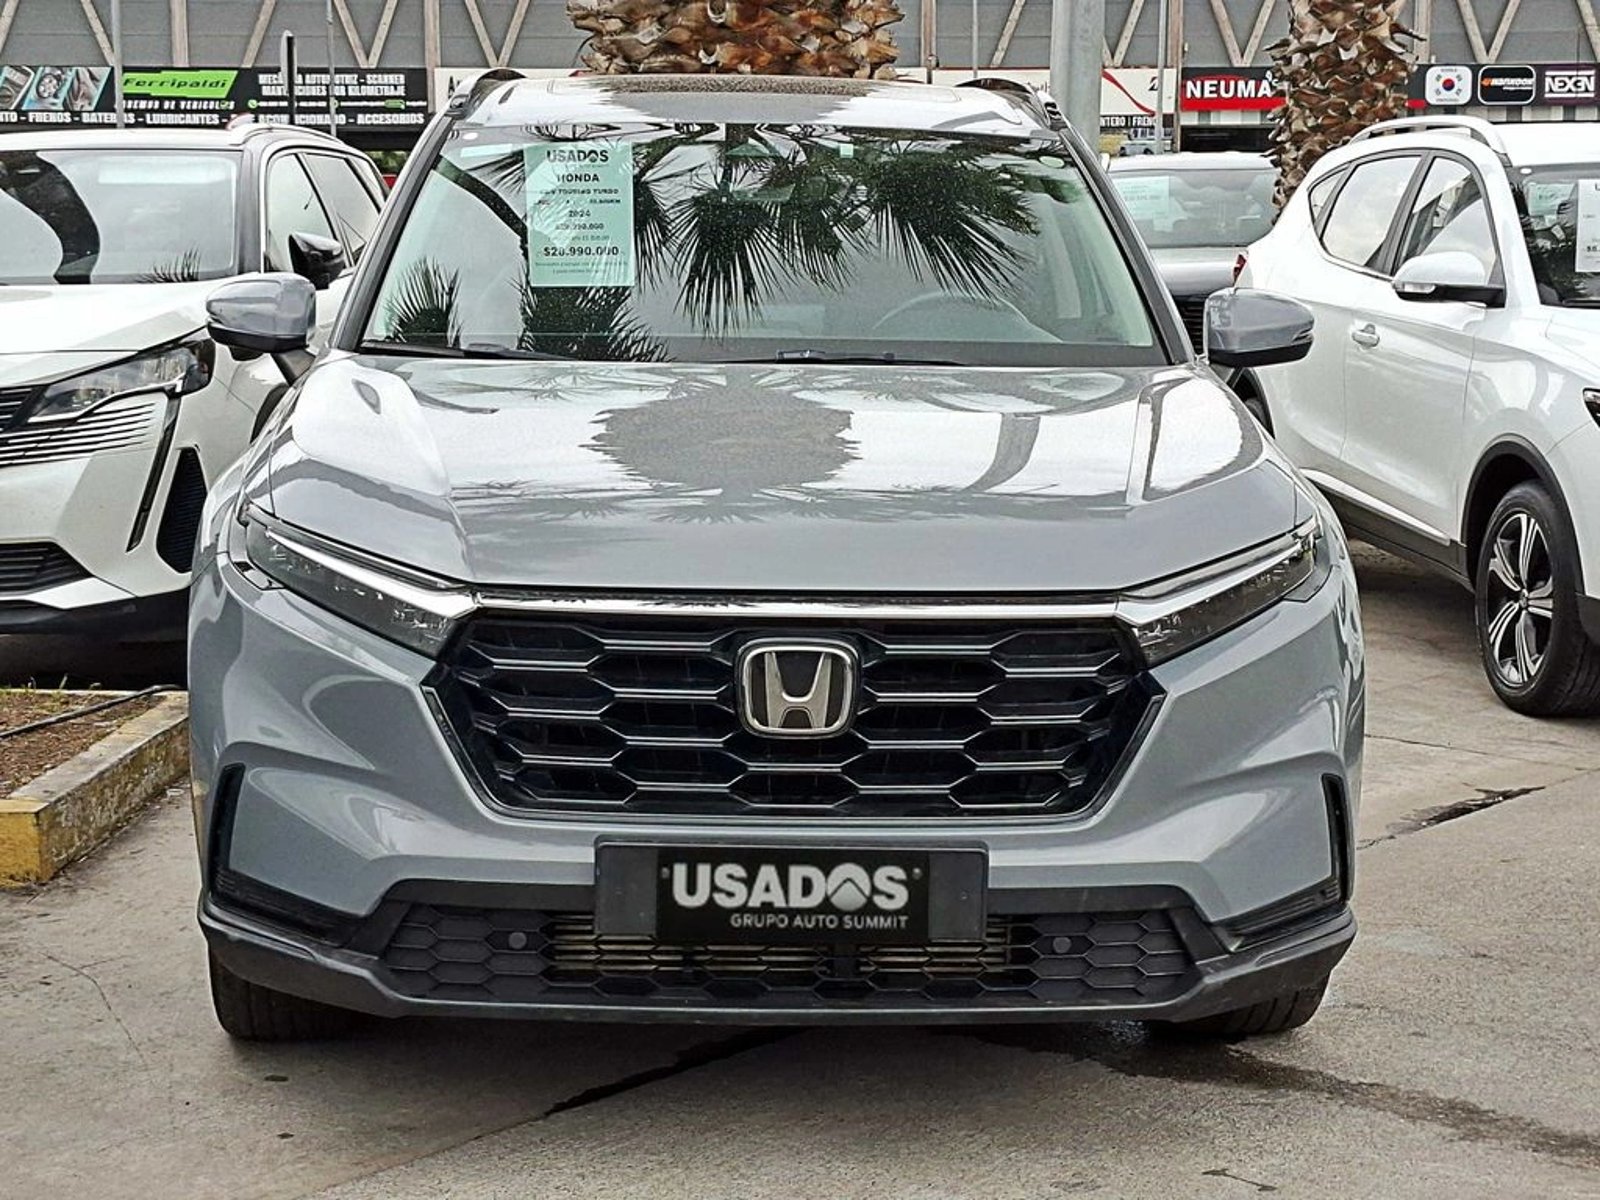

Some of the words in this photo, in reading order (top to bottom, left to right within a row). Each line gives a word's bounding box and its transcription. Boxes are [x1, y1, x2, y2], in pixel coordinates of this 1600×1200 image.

[122, 79, 227, 89] Ferripaldi
[1544, 75, 1595, 93] NEXEN
[28, 111, 72, 123] FRENOS
[145, 113, 220, 125] LUBRICANTES
[356, 113, 425, 125] ACCESORIOS
[546, 149, 609, 163] USADOS
[557, 172, 600, 183] HONDA
[671, 861, 909, 911] USADOS
[730, 914, 789, 929] GRUPO
[793, 915, 838, 929] AUTO
[843, 915, 909, 930] SUMMIT
